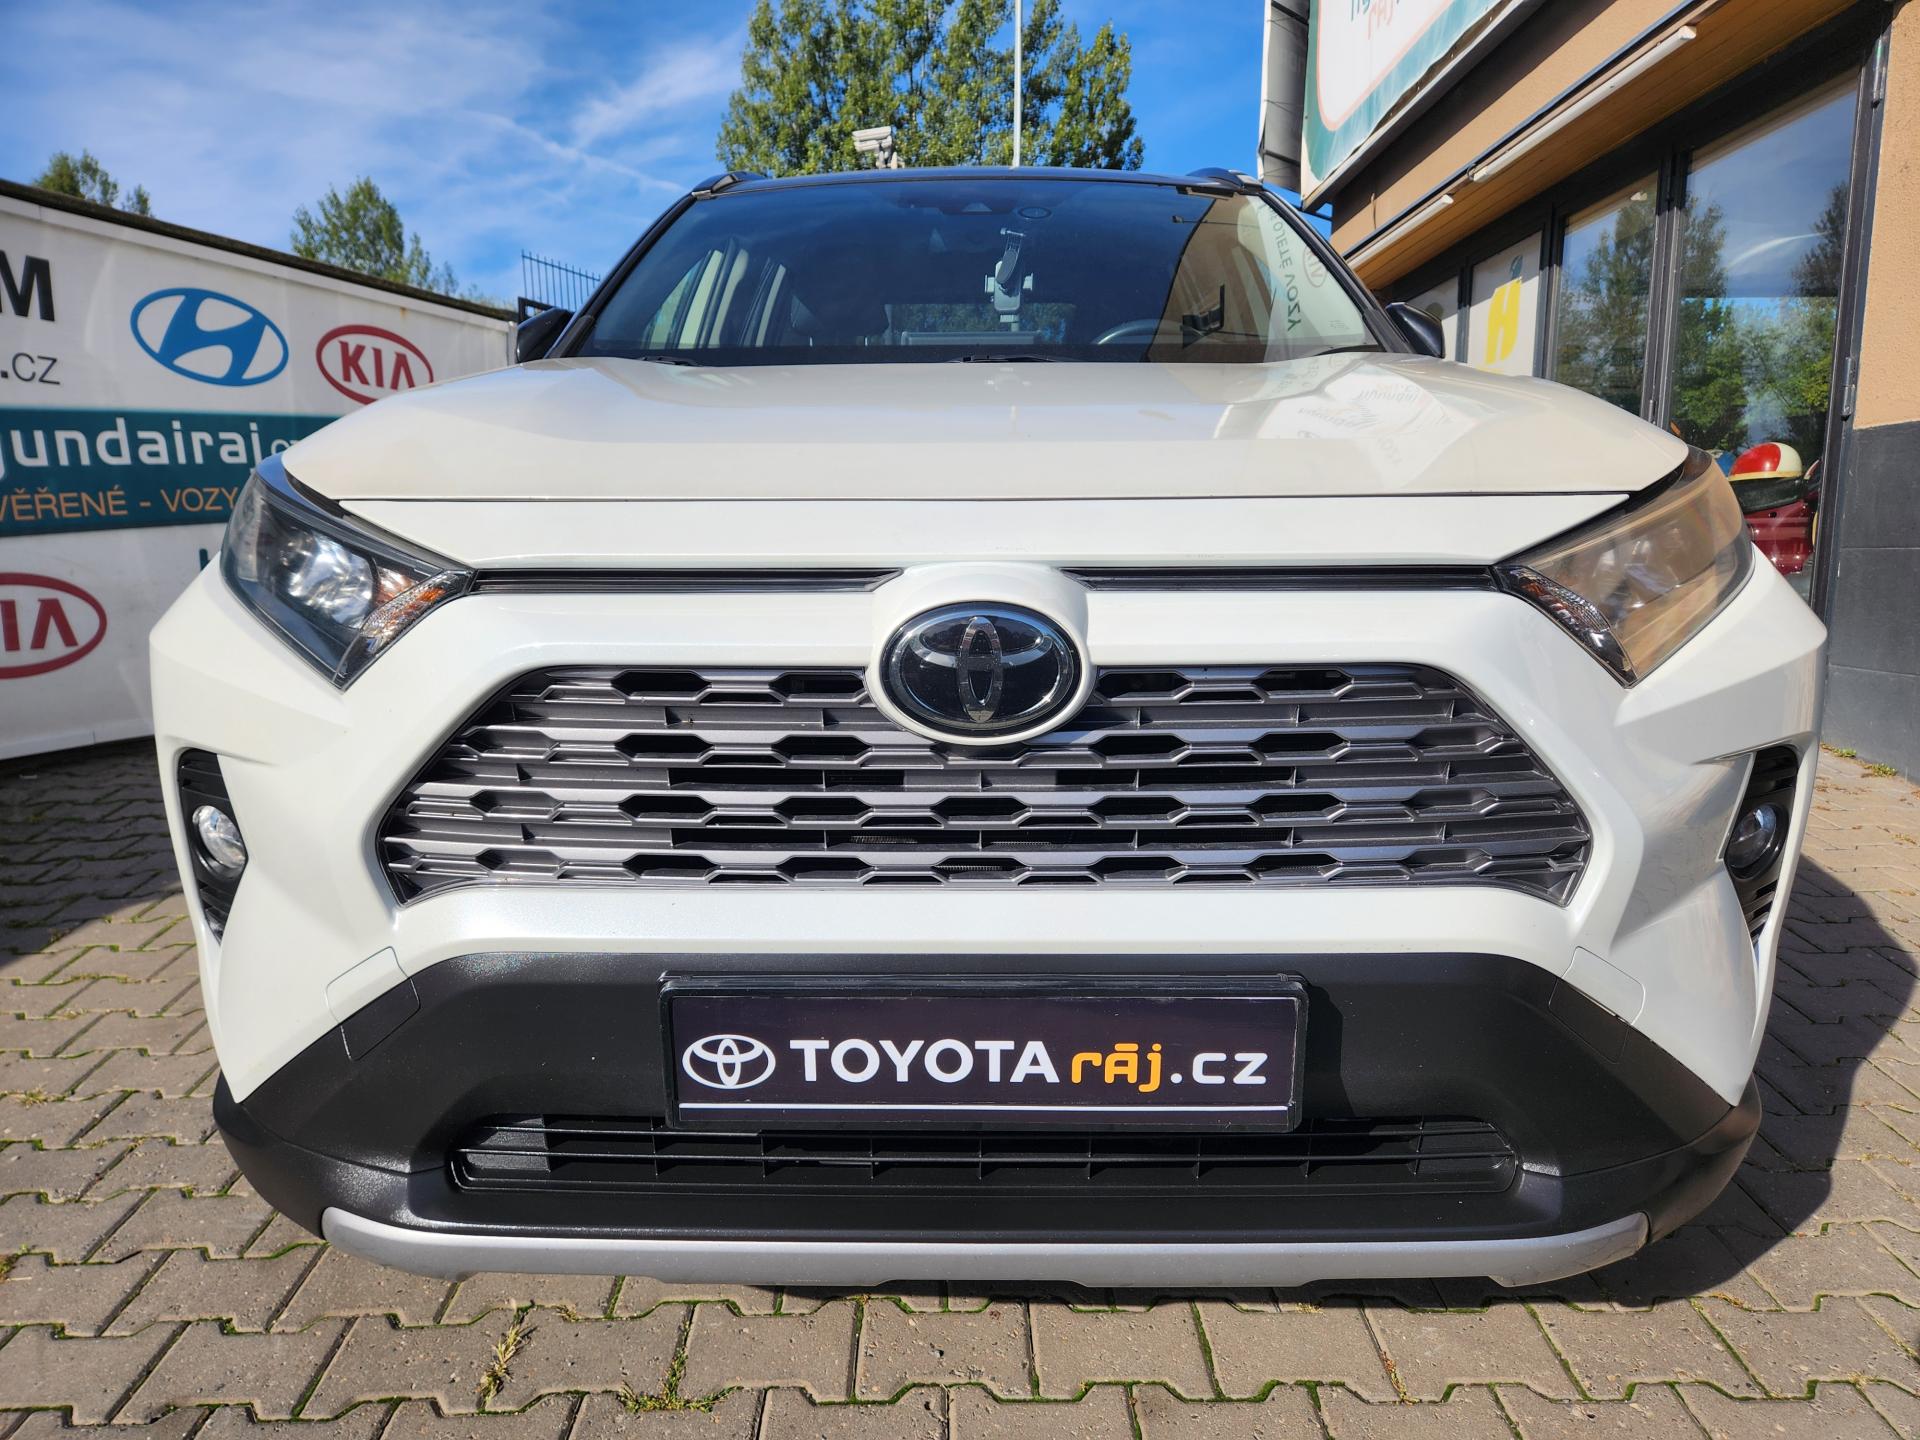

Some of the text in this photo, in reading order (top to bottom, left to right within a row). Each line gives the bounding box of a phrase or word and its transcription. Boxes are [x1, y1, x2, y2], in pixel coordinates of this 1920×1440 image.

[338, 340, 415, 391] KIA
[160, 487, 239, 512] VOZY
[0, 597, 79, 652] IA
[789, 1038, 1060, 1084] TOYOTA
